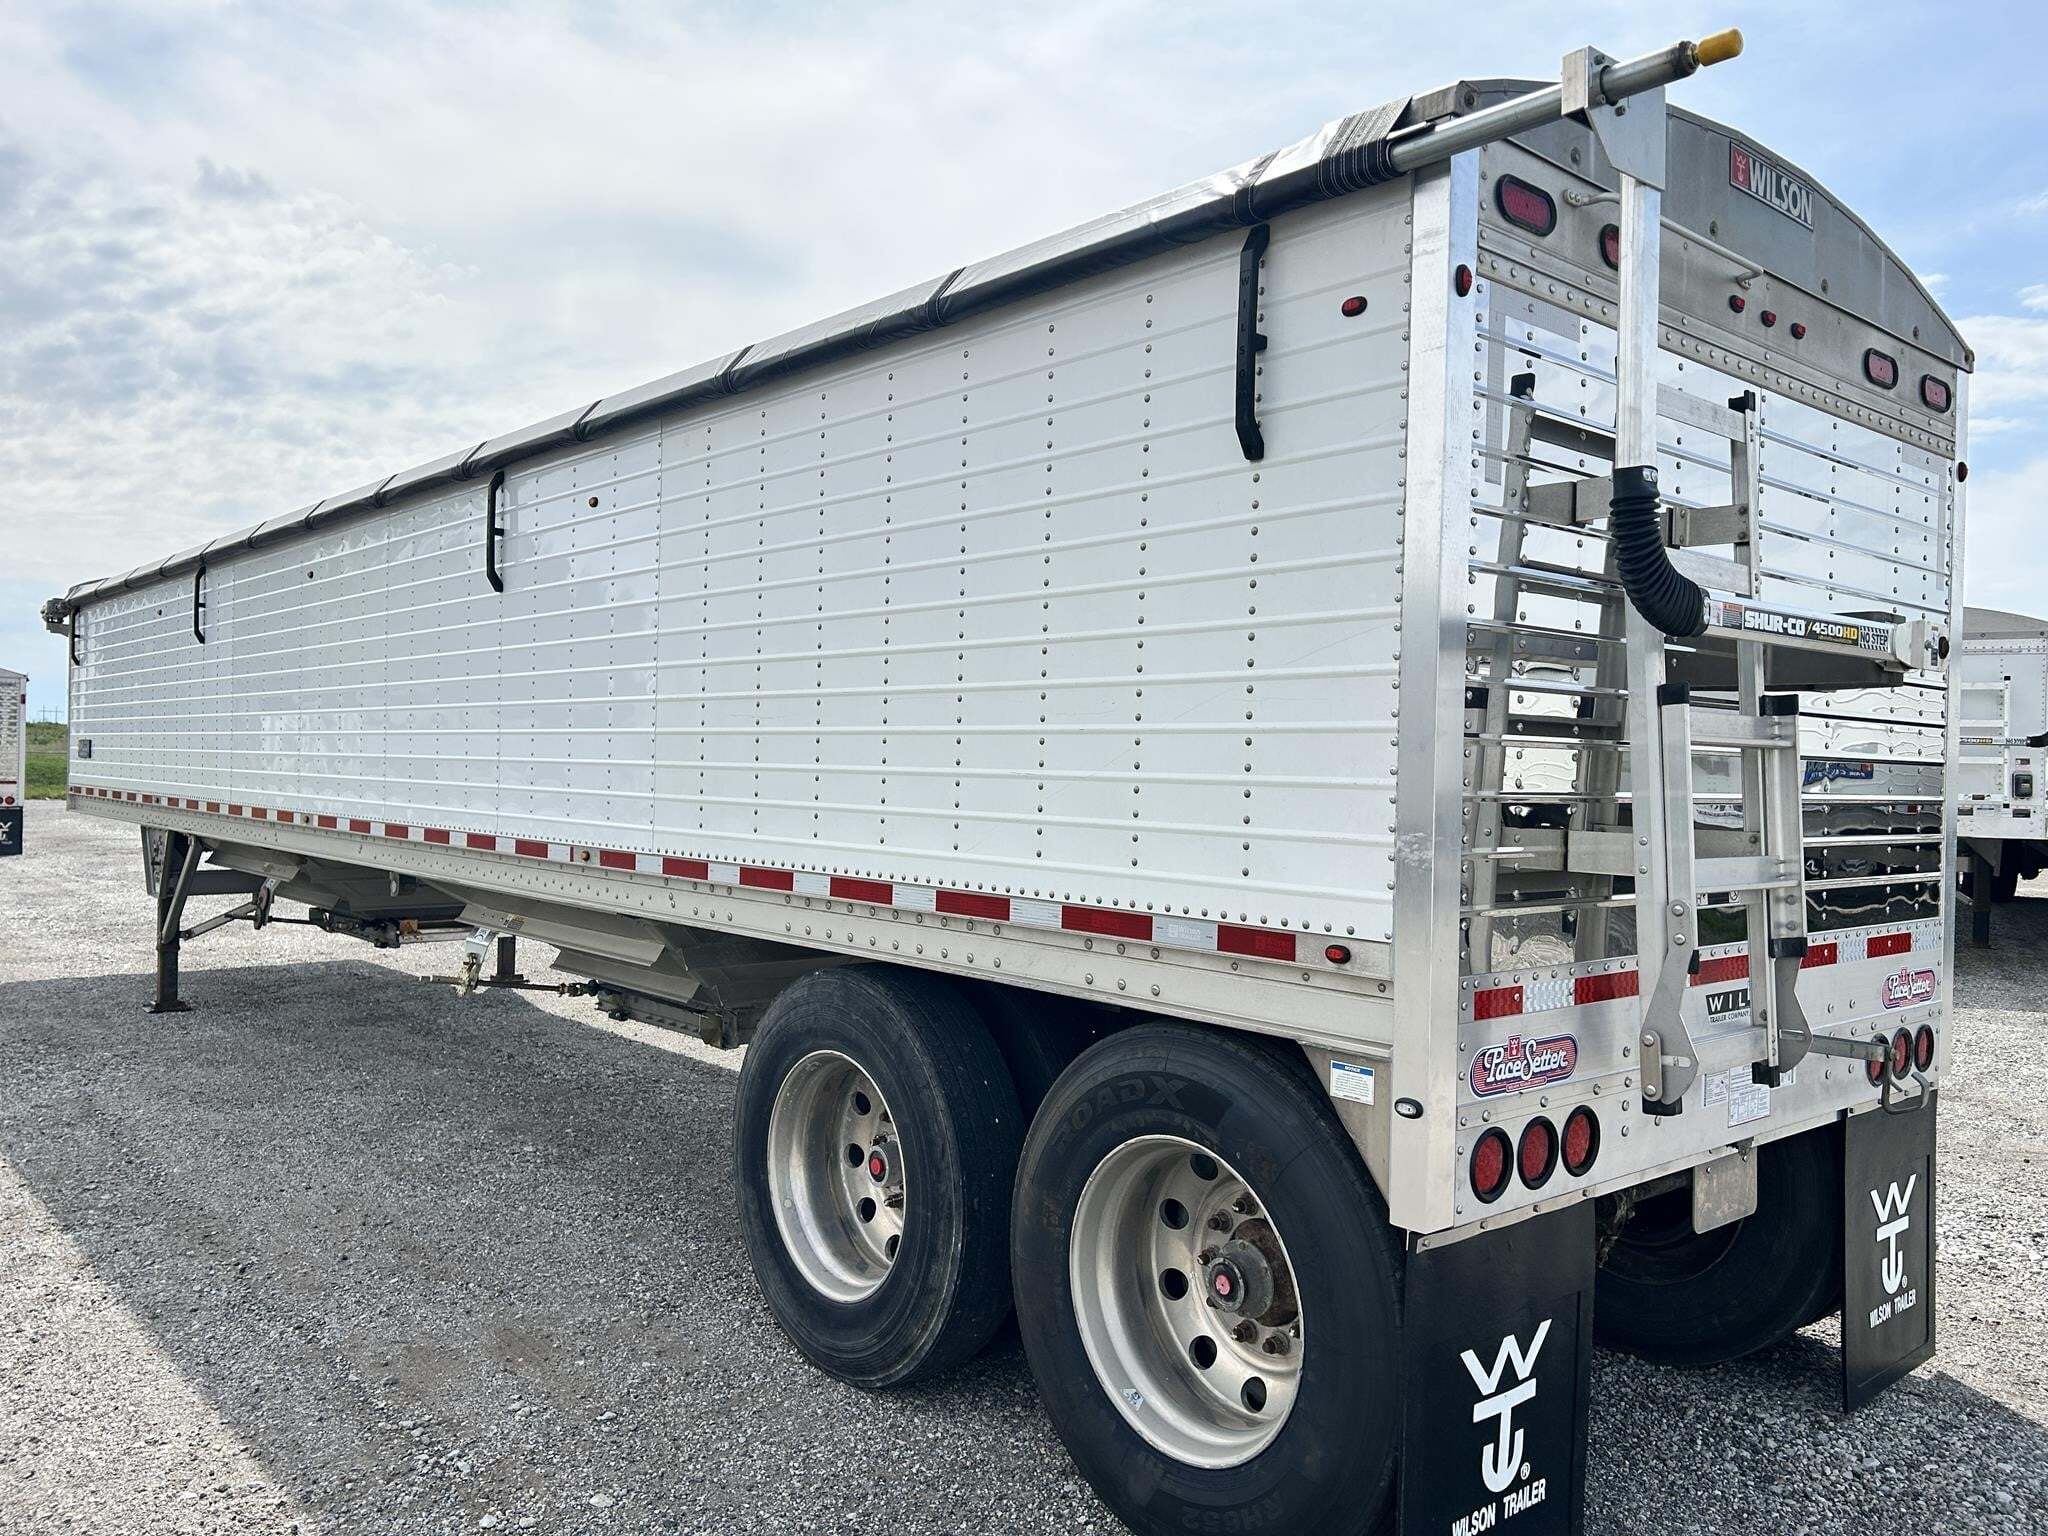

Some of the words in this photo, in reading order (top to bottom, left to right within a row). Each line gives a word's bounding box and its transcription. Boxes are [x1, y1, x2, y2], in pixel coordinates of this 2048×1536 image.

[1749, 157, 1813, 225] WILSON
[1744, 610, 1806, 636] SHUR-CO
[1860, 631, 1870, 643] NO
[1871, 633, 1888, 646] STEP
[1708, 991, 1747, 1012] WIL
[1869, 1301, 1892, 1329] WILSON
[1894, 1288, 1917, 1315] TRAILER
[1452, 1502, 1496, 1536] WILSON
[1503, 1478, 1546, 1519] TRAILER
